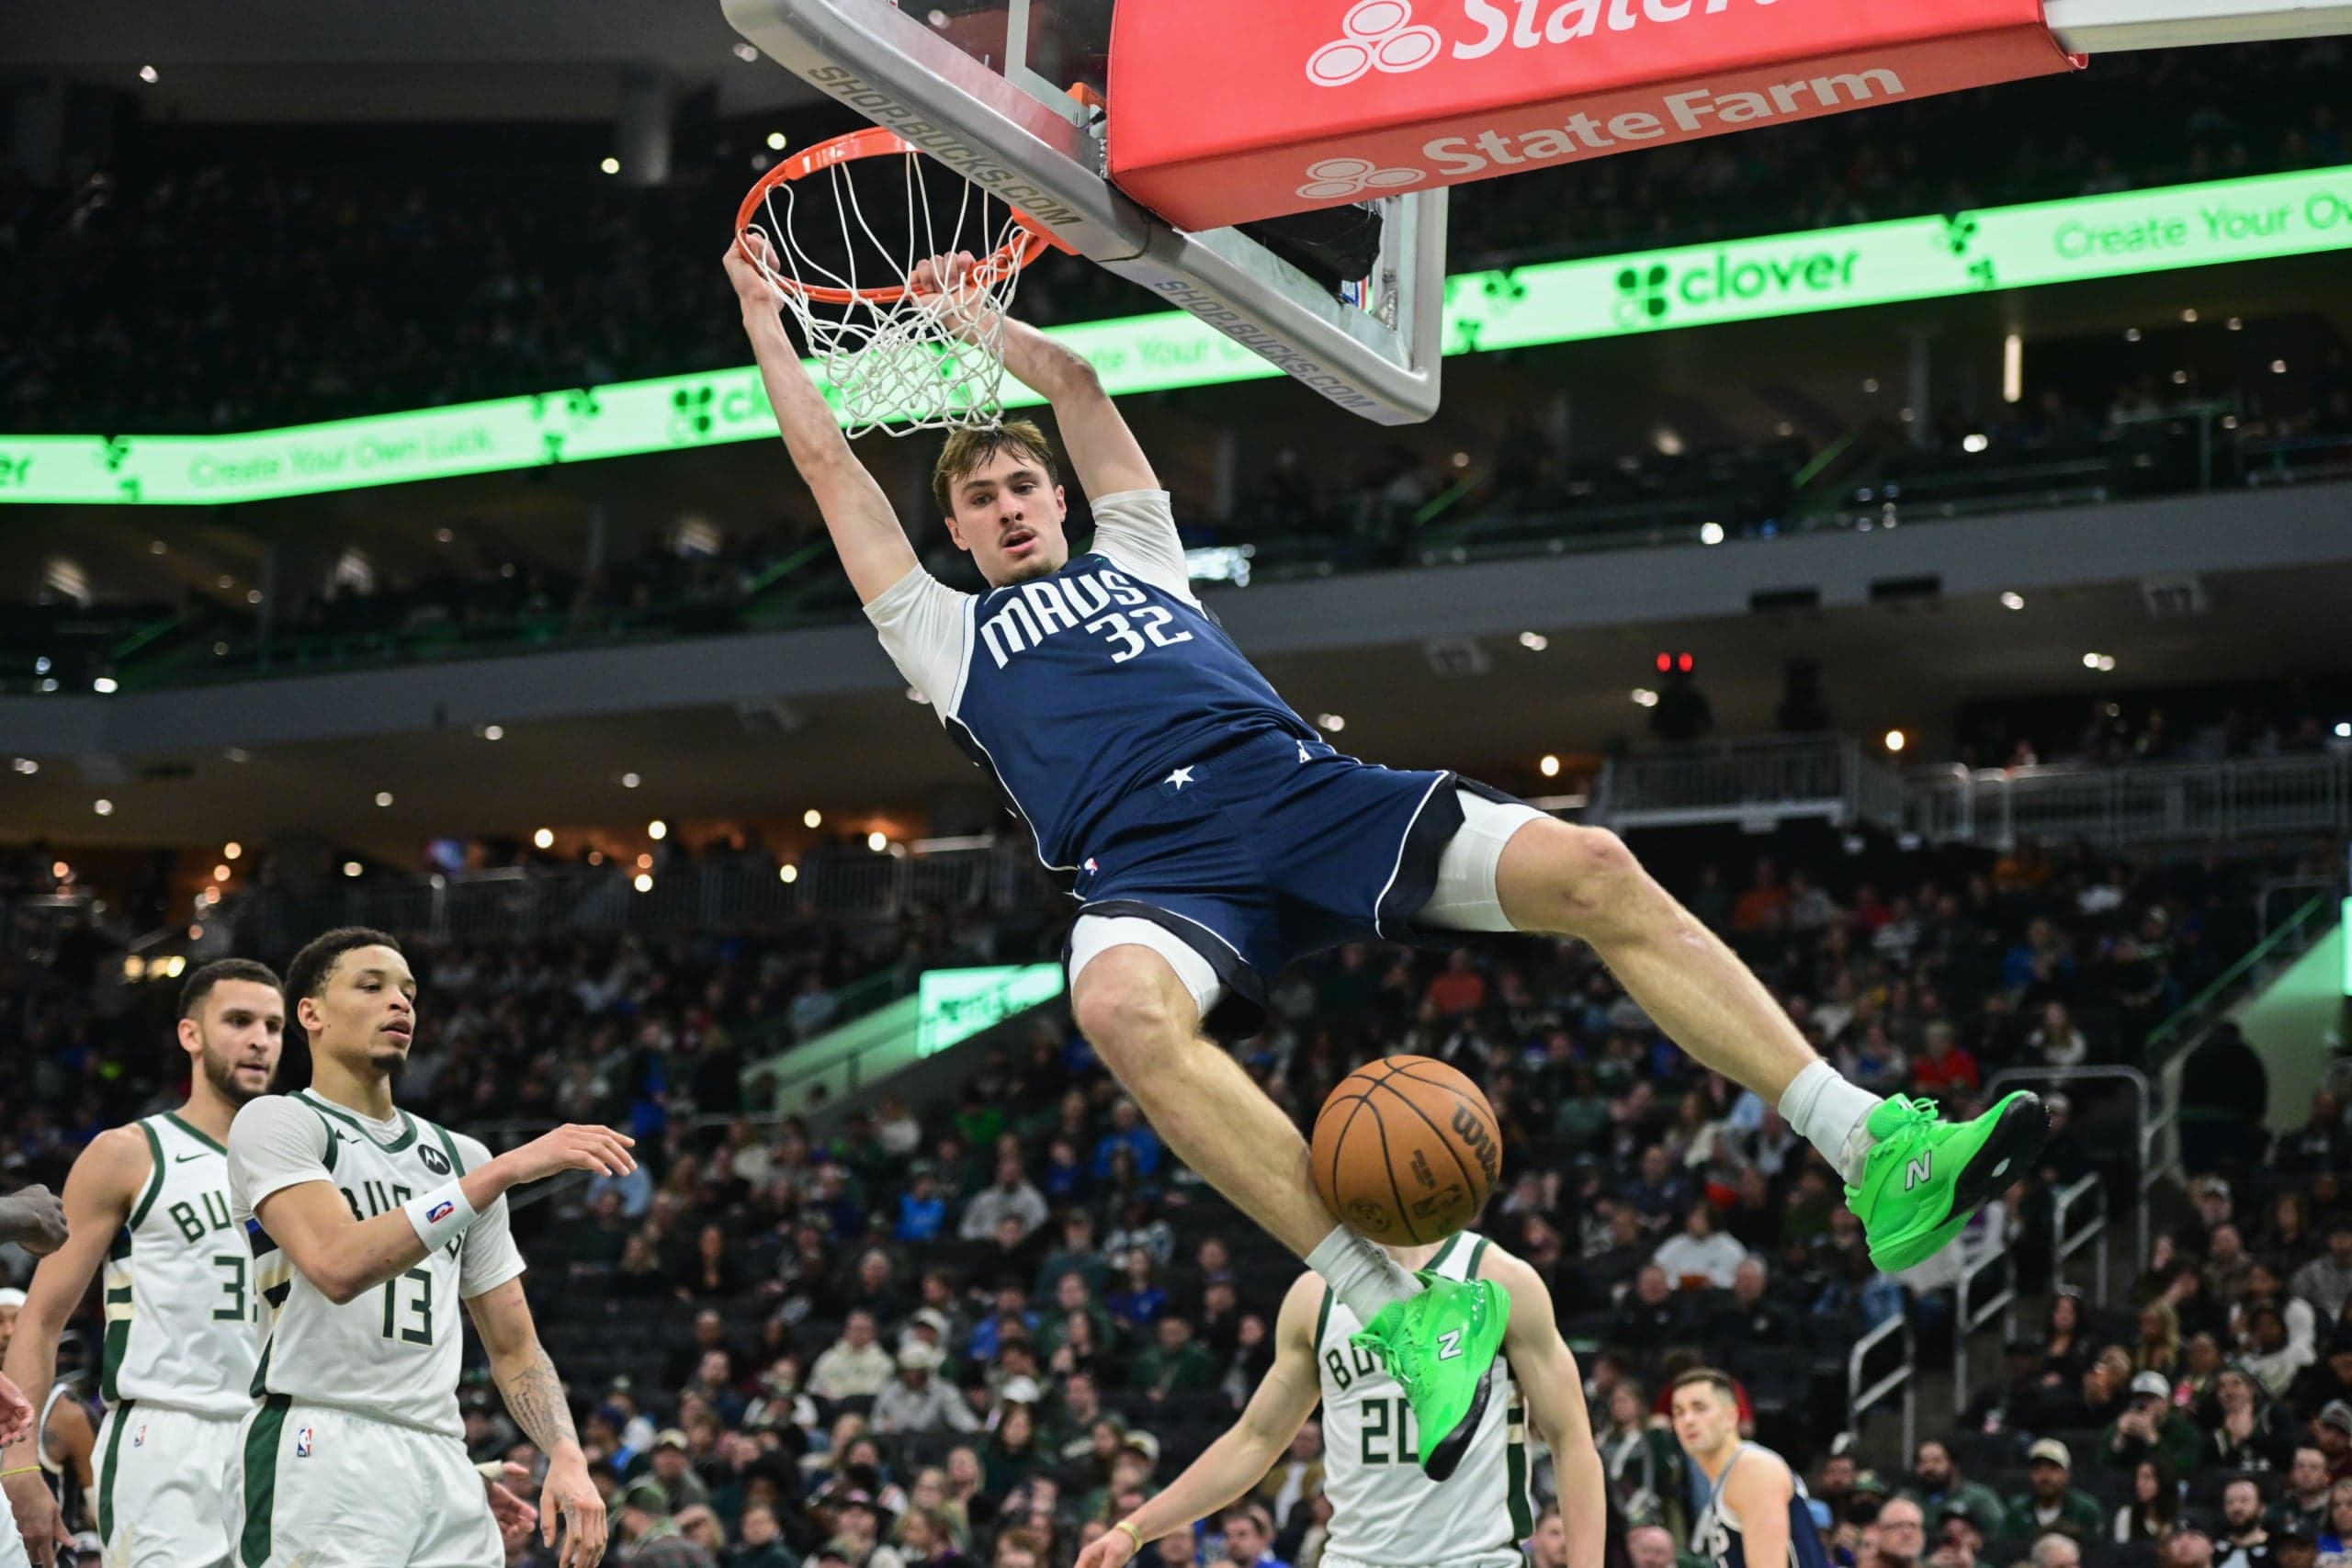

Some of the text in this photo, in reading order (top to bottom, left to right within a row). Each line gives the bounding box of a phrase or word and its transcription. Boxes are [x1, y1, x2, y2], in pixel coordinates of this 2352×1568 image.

[808, 66, 1083, 227] SHOP.BUCKS.COM
[2053, 217, 2188, 260] Create
[2199, 202, 2292, 242] Your
[1679, 248, 1860, 306] clover
[1154, 280, 1378, 410] SHOP.BUCKS.COM
[979, 570, 1148, 670] MAVS
[1084, 605, 1193, 663] 32
[381, 1266, 435, 1348] 13
